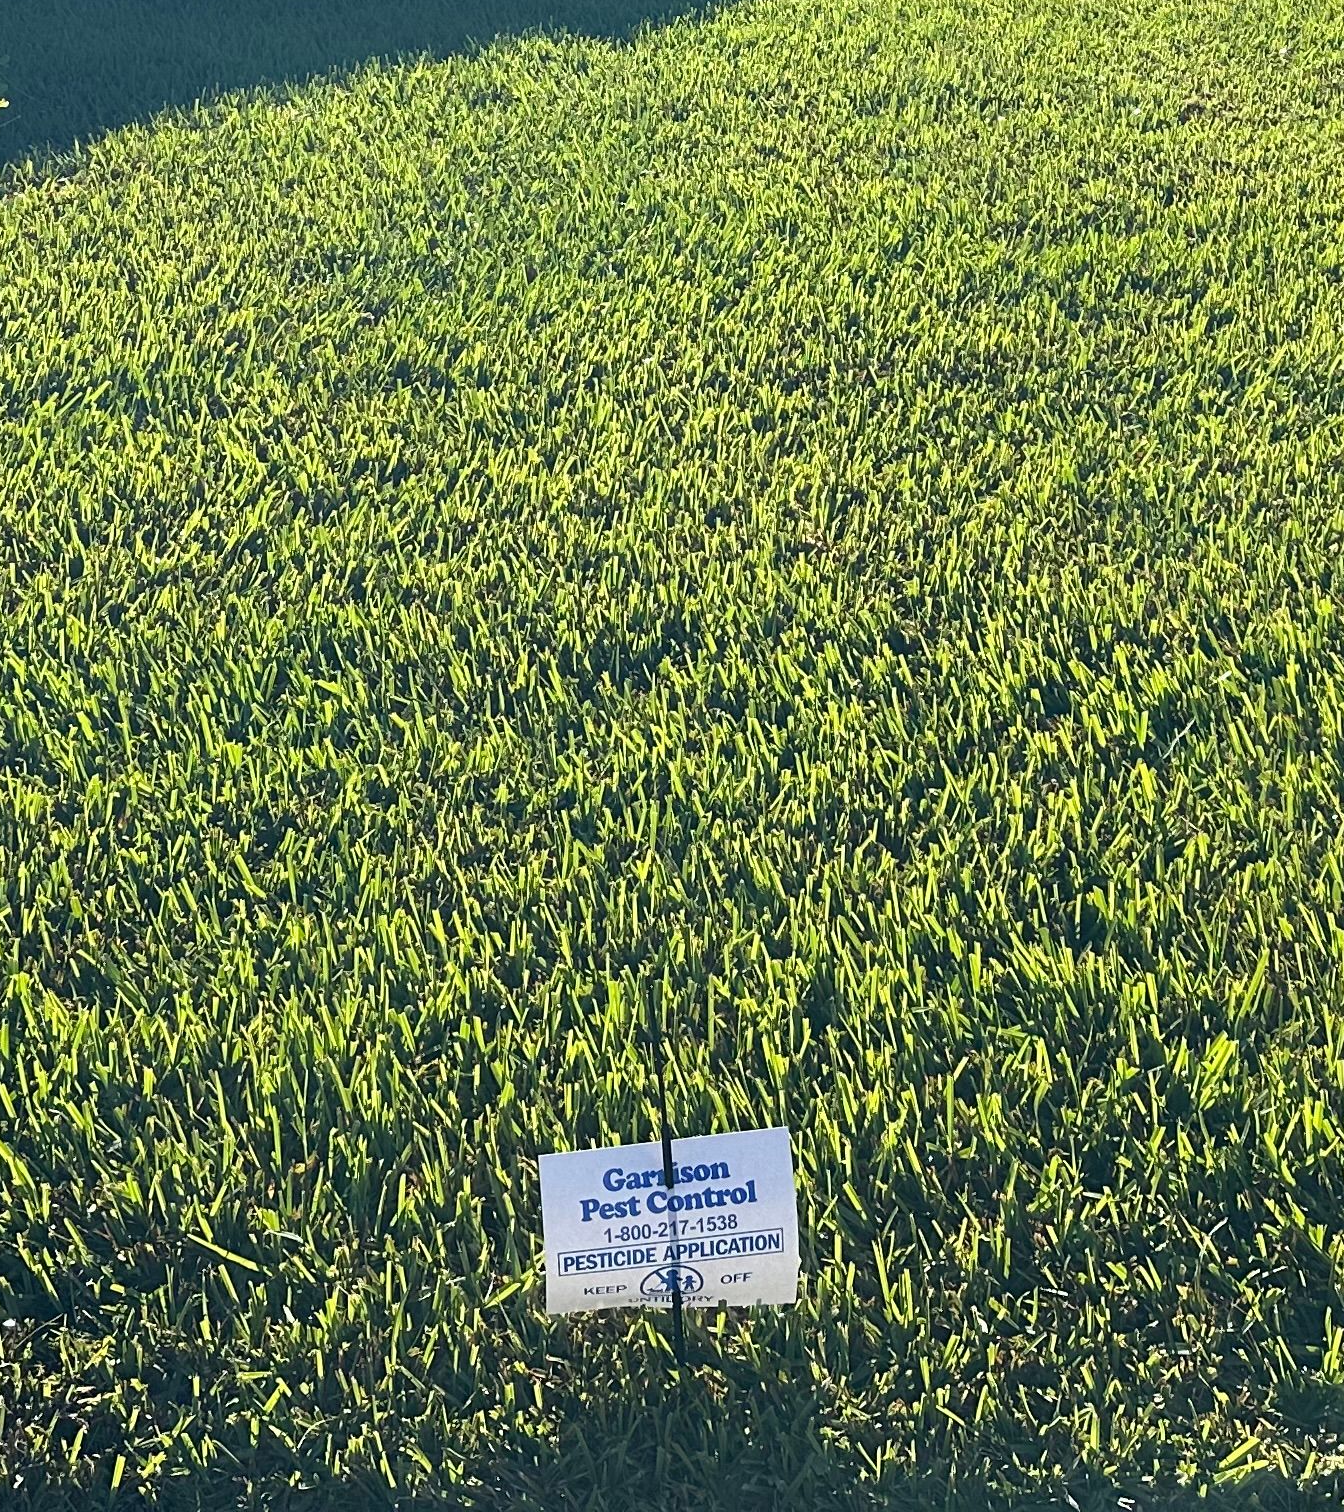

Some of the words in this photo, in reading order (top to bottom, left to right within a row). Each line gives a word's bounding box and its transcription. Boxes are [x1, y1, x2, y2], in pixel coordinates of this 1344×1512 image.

[580, 1195, 641, 1222] Pest
[646, 1179, 758, 1214] Control
[603, 1214, 738, 1243] 1-800-217-1538
[563, 1247, 657, 1273] PESTICIDE
[662, 1232, 780, 1262] APPLICATION
[583, 1284, 628, 1296] KEEP
[720, 1272, 753, 1284] OFF
